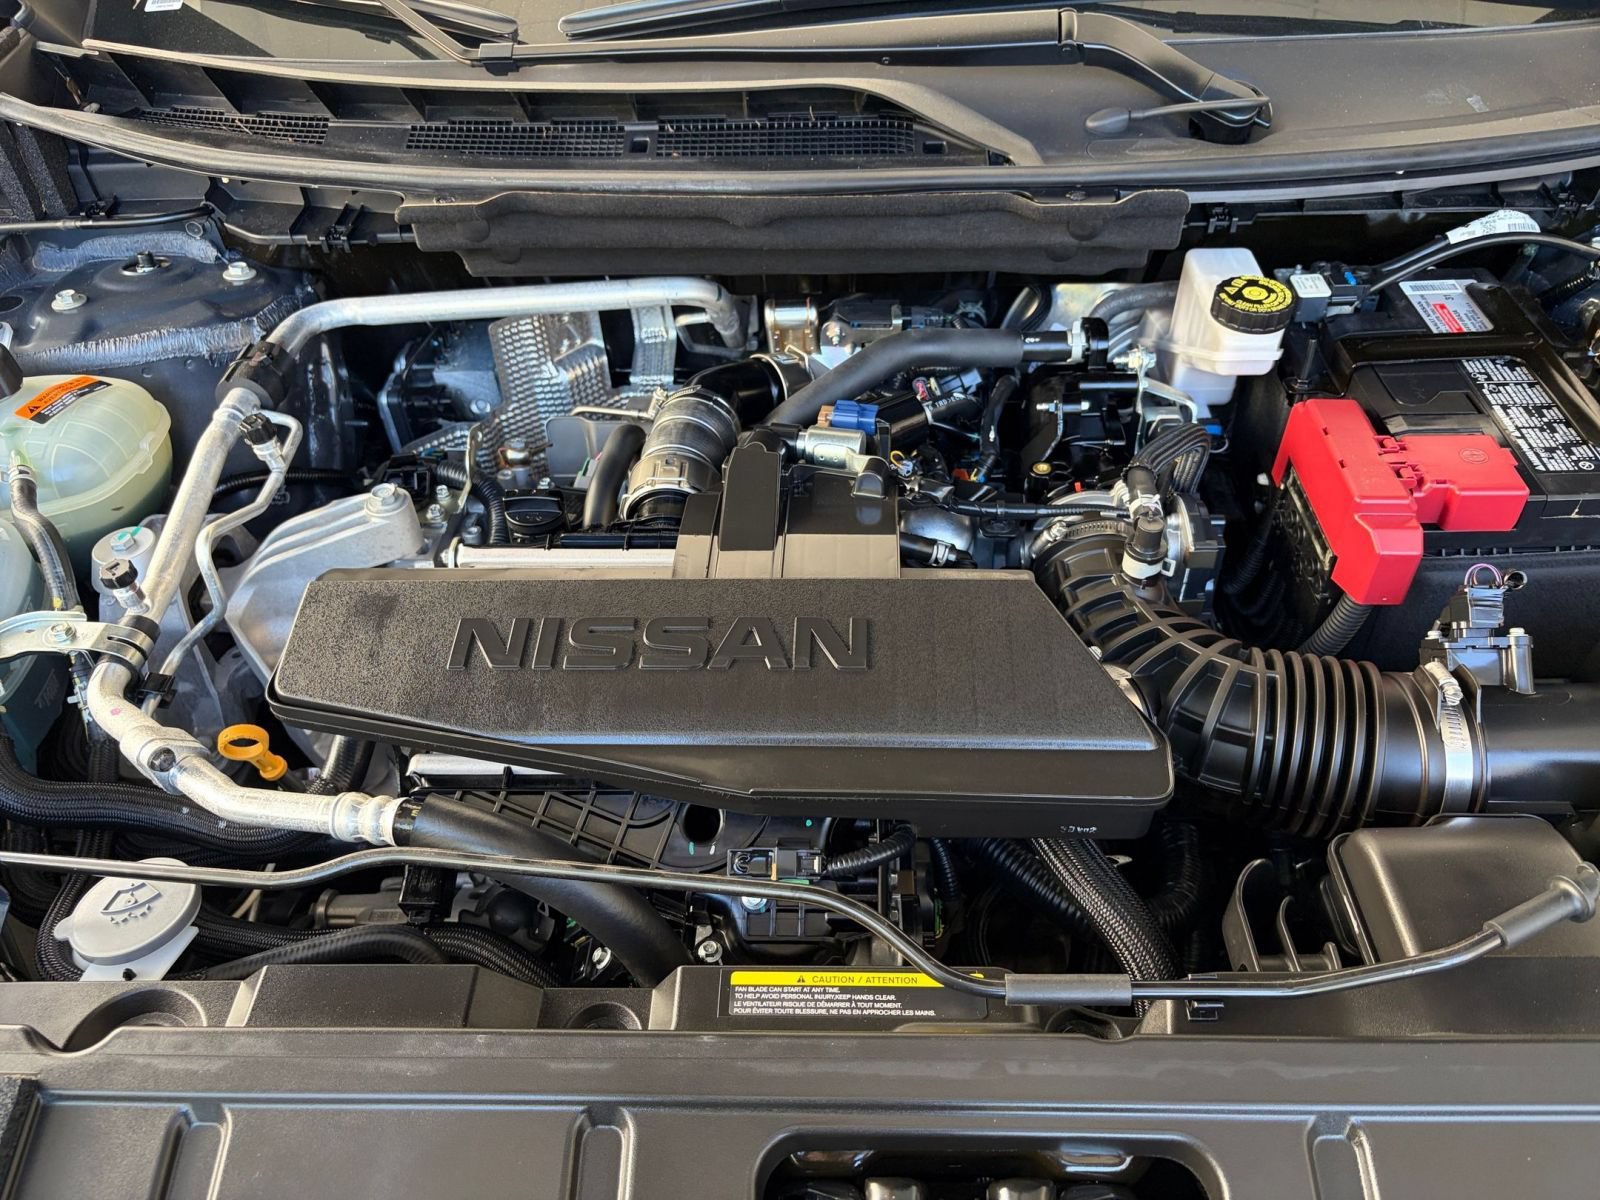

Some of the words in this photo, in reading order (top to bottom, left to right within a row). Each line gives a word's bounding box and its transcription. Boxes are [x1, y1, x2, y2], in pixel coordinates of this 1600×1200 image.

[446, 616, 870, 670] NISSAN
[812, 975, 854, 983] CAUTION
[865, 976, 918, 984] ATTENTION
[817, 1000, 850, 1008] DÉMARRER
